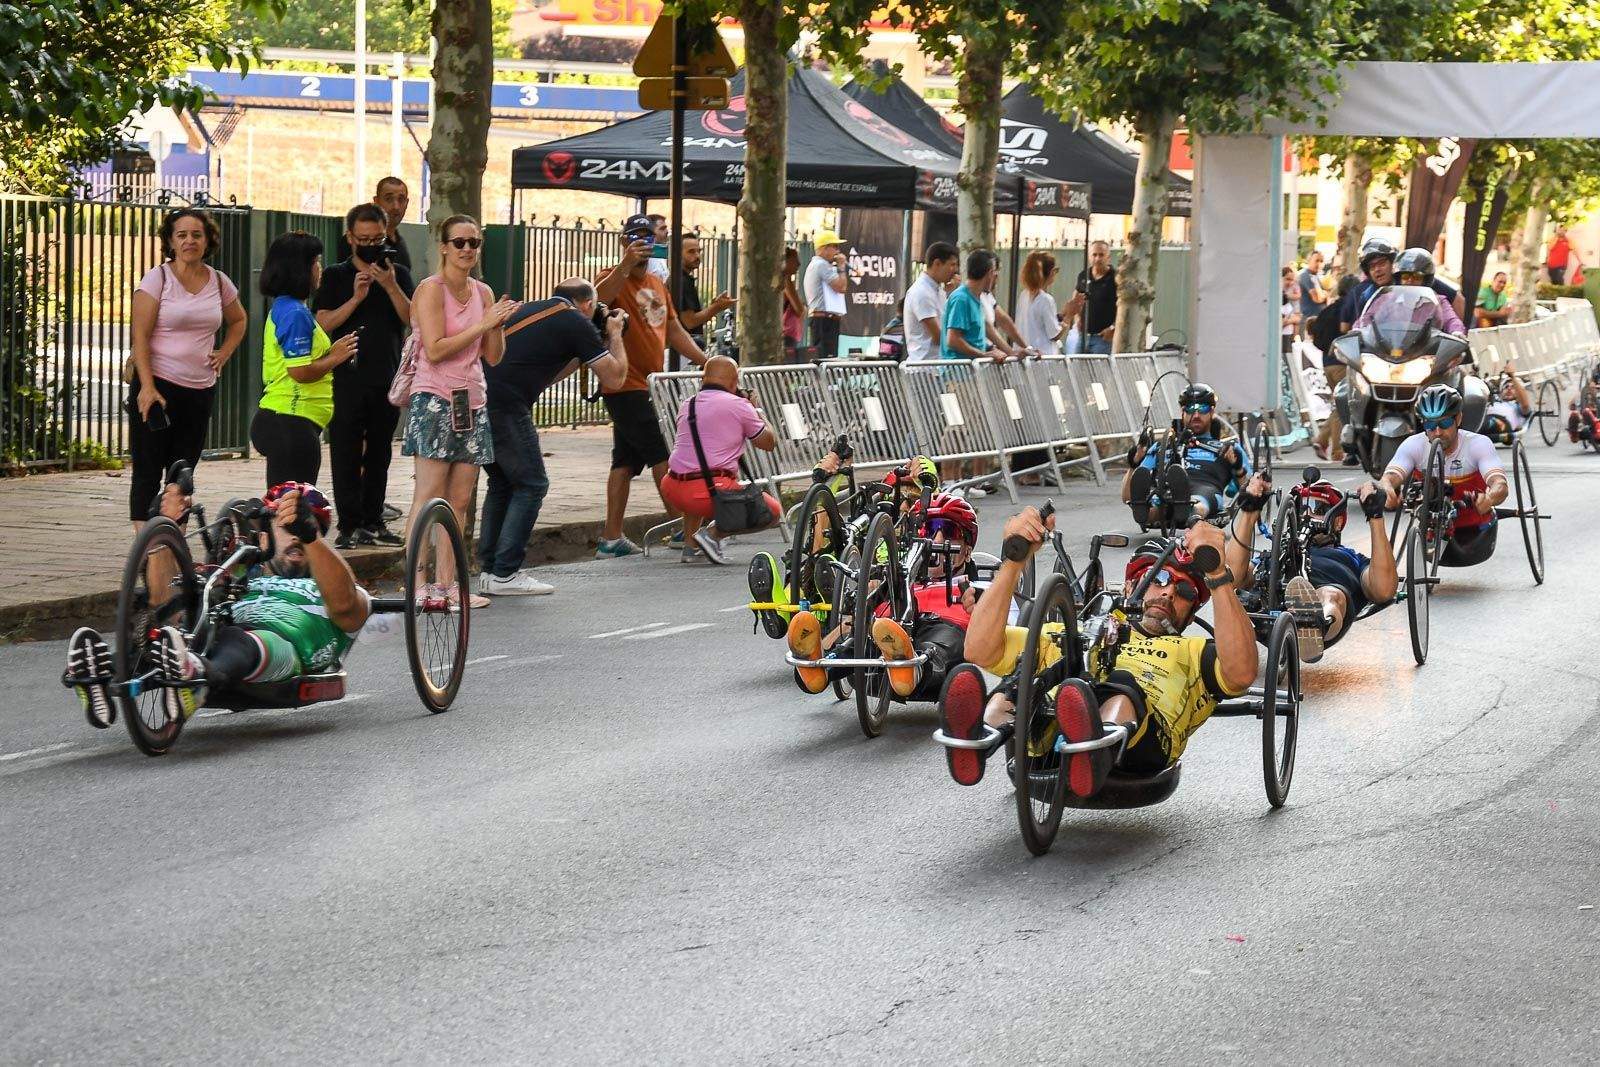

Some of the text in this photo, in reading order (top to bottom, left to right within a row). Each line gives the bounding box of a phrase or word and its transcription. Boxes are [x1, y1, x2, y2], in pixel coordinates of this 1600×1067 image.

[300, 76, 321, 97] 2
[519, 84, 539, 106] 3
[579, 158, 693, 182] 24MX
[816, 181, 841, 191] GRANDE
[841, 183, 851, 192] DE
